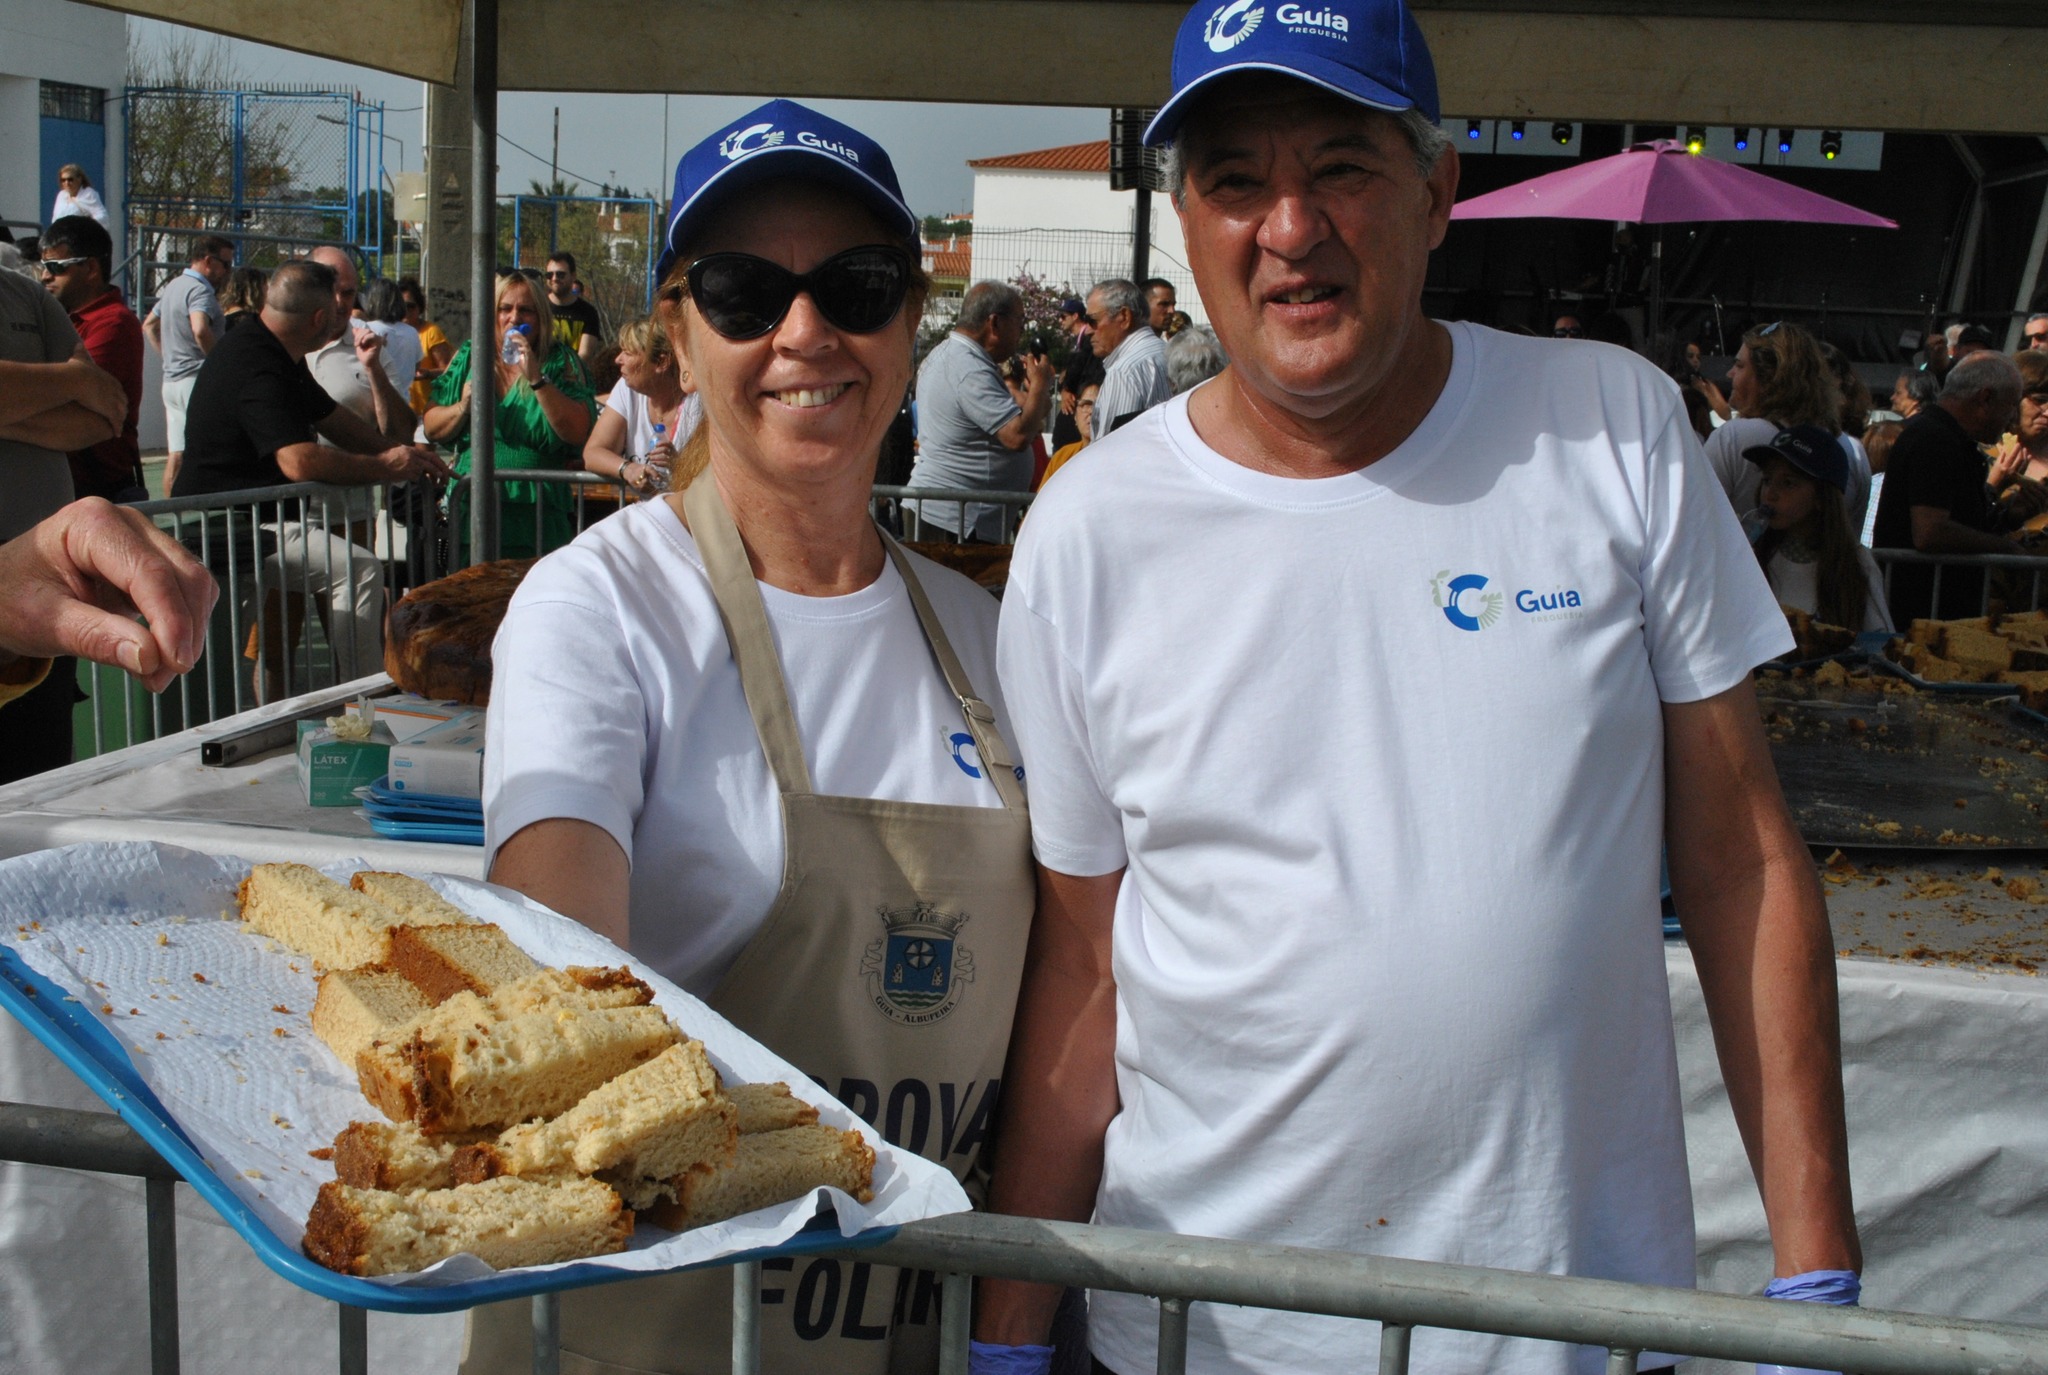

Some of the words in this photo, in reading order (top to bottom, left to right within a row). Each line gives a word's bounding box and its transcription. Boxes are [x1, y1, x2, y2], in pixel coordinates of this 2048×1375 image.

[1276, 4, 1349, 32] Guia
[1289, 27, 1348, 43] FREGUESIA
[797, 131, 859, 163] Guia
[1515, 585, 1582, 613] Guia
[314, 754, 347, 764] LÁTEX
[875, 996, 893, 1016] GUIA
[903, 1001, 954, 1023] ALBUFEIRA
